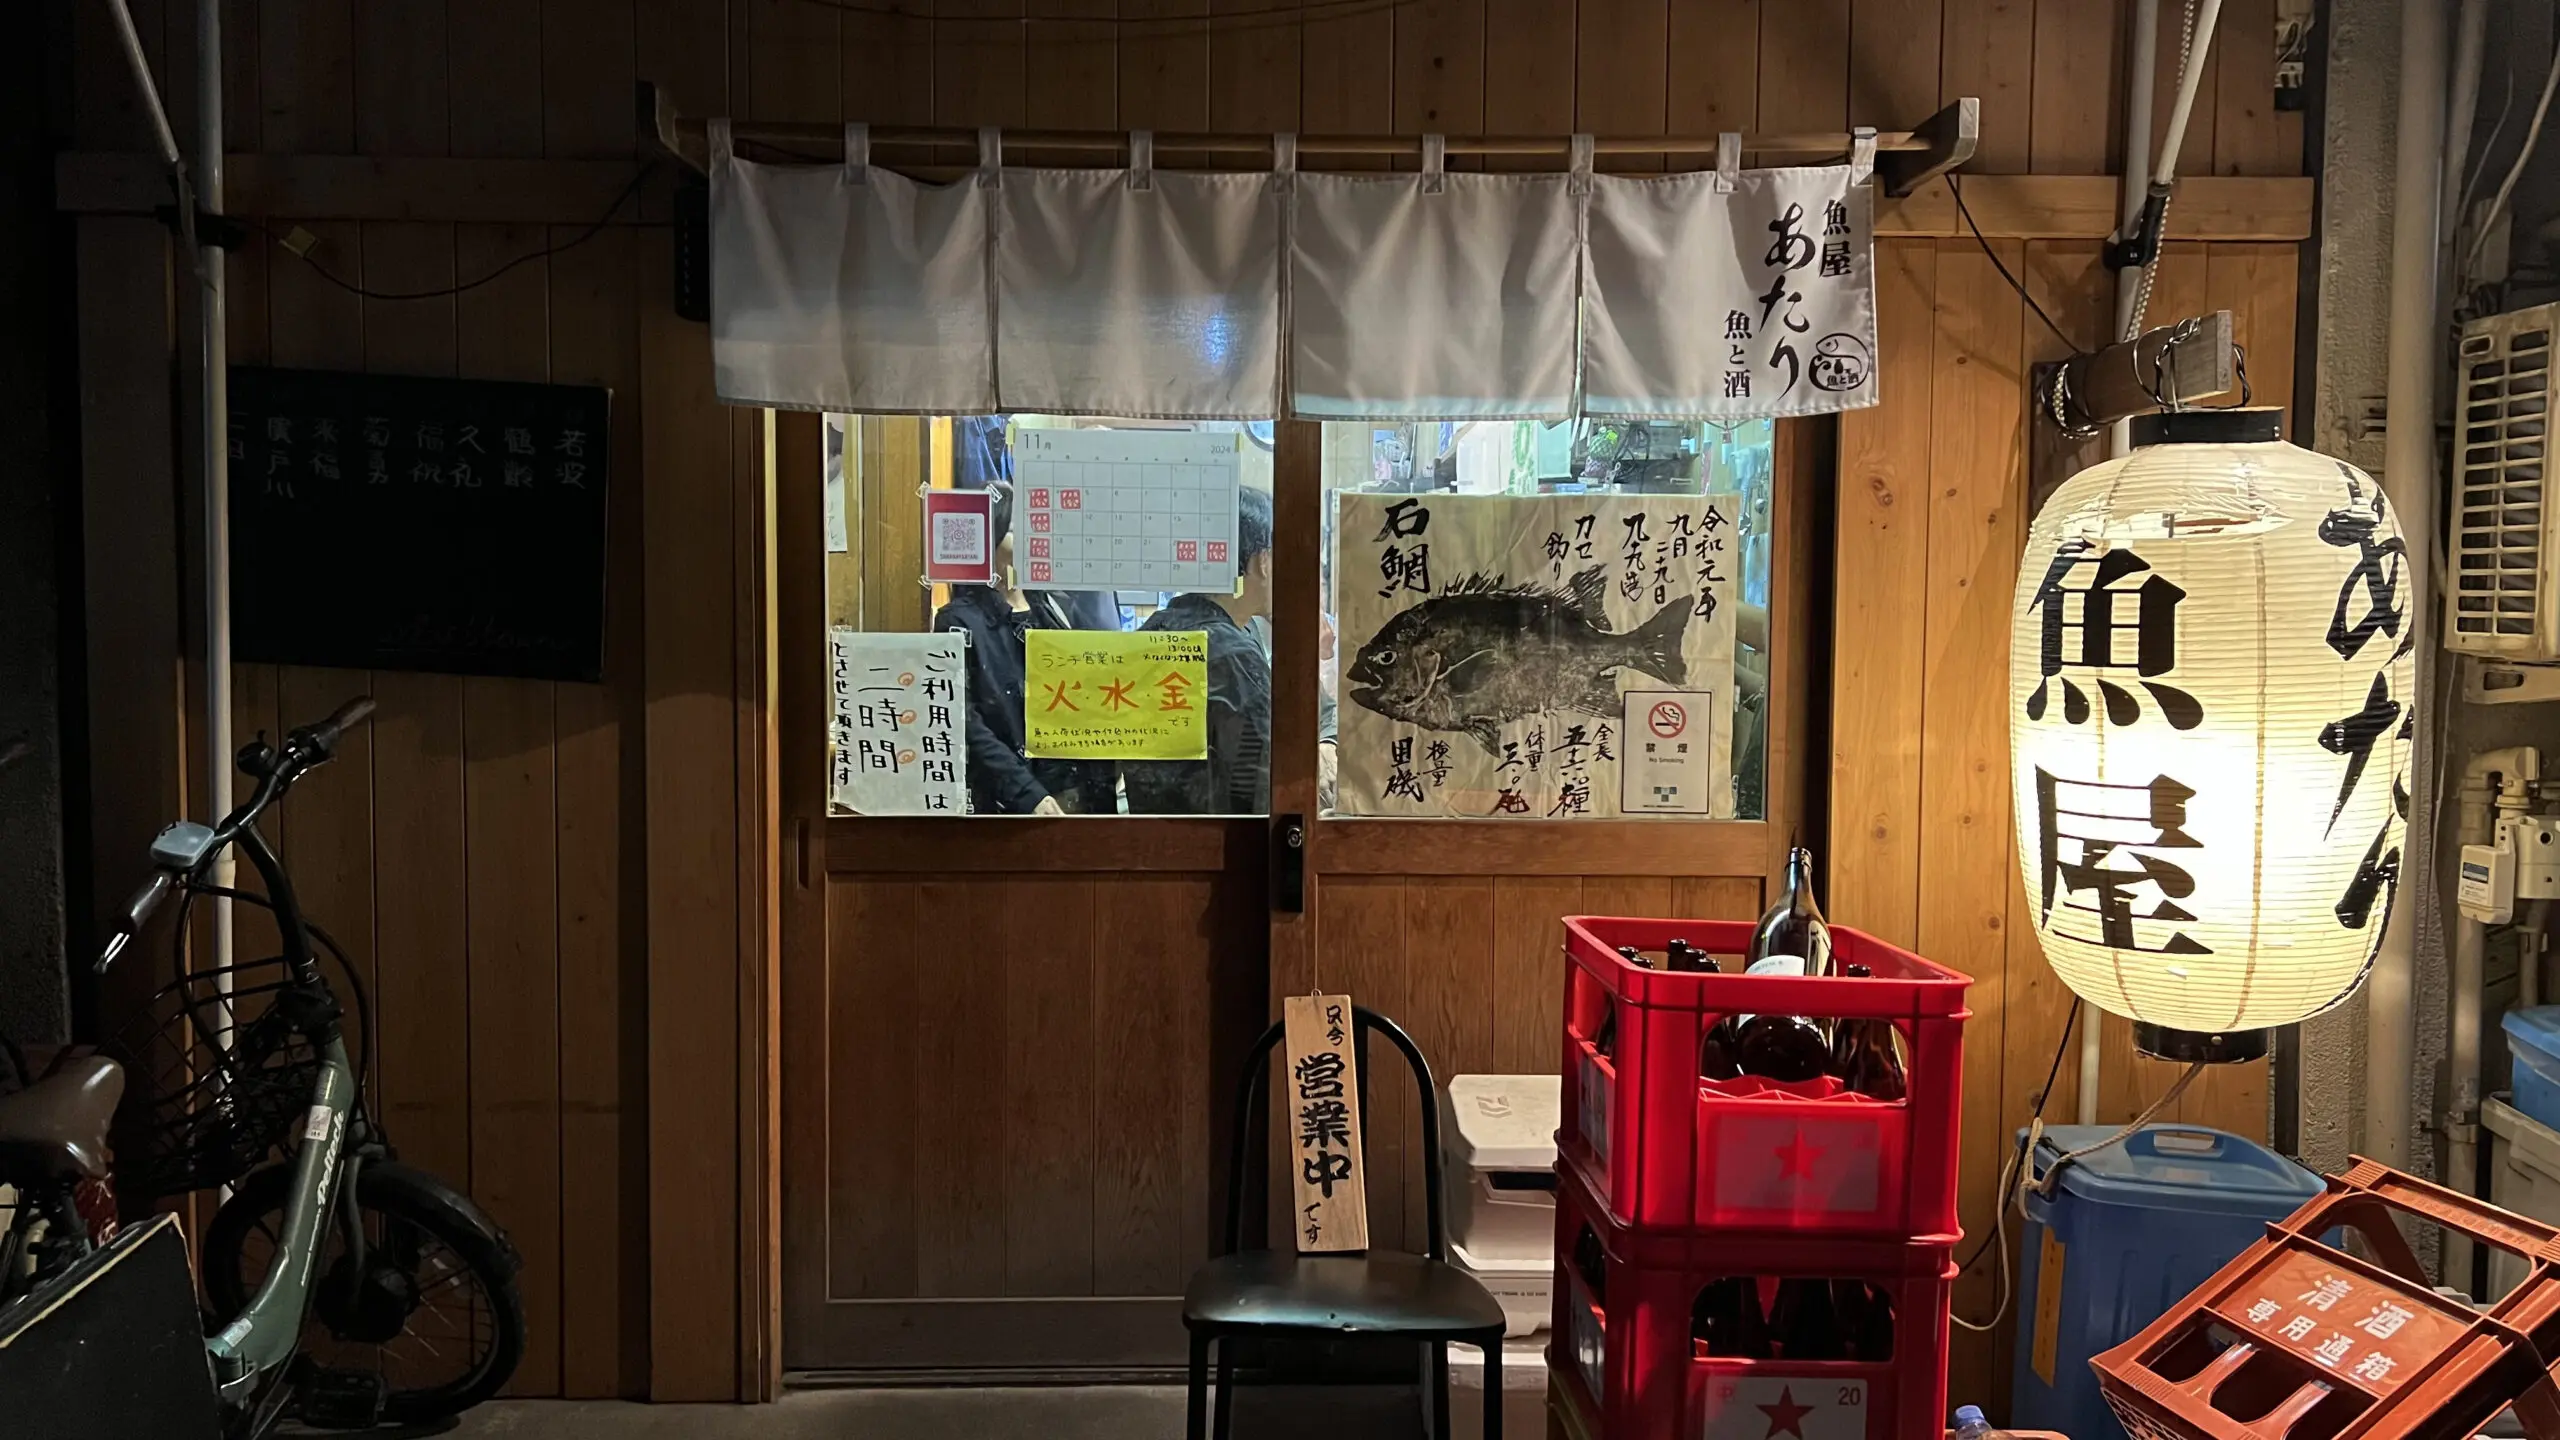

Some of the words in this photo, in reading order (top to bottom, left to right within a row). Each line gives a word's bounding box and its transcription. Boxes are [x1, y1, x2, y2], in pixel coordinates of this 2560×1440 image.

[1819, 199, 1852, 278] 魚屋
[1758, 202, 1816, 401] あたり
[1724, 309, 1752, 398] 魚と酒
[553, 429, 588, 490] 若波
[1211, 446, 1230, 454] 2024
[1372, 498, 1430, 598] 石鯛
[1541, 532, 1570, 580] 釣り
[1666, 514, 1694, 558] 九月
[1695, 505, 1729, 623] 令和元年
[1652, 542, 1674, 604] 二十九日
[1042, 651, 1124, 668] ランチ営業は
[834, 643, 852, 785] とさせて頂きます
[858, 668, 904, 774] 二時間
[921, 650, 956, 810] ご利用時間は
[1168, 717, 1191, 726] です
[1591, 723, 1615, 761] 全長
[2026, 535, 2214, 955] 魚屋
[1525, 725, 1545, 771] 体重
[1326, 1005, 1345, 1046] 只今
[1295, 1052, 1352, 1199] 営業中
[1304, 1202, 1321, 1244] です
[2297, 1273, 2415, 1340] 清酒
[2245, 1297, 2399, 1382] 専用通箱
[1838, 1387, 1861, 1406] 20
